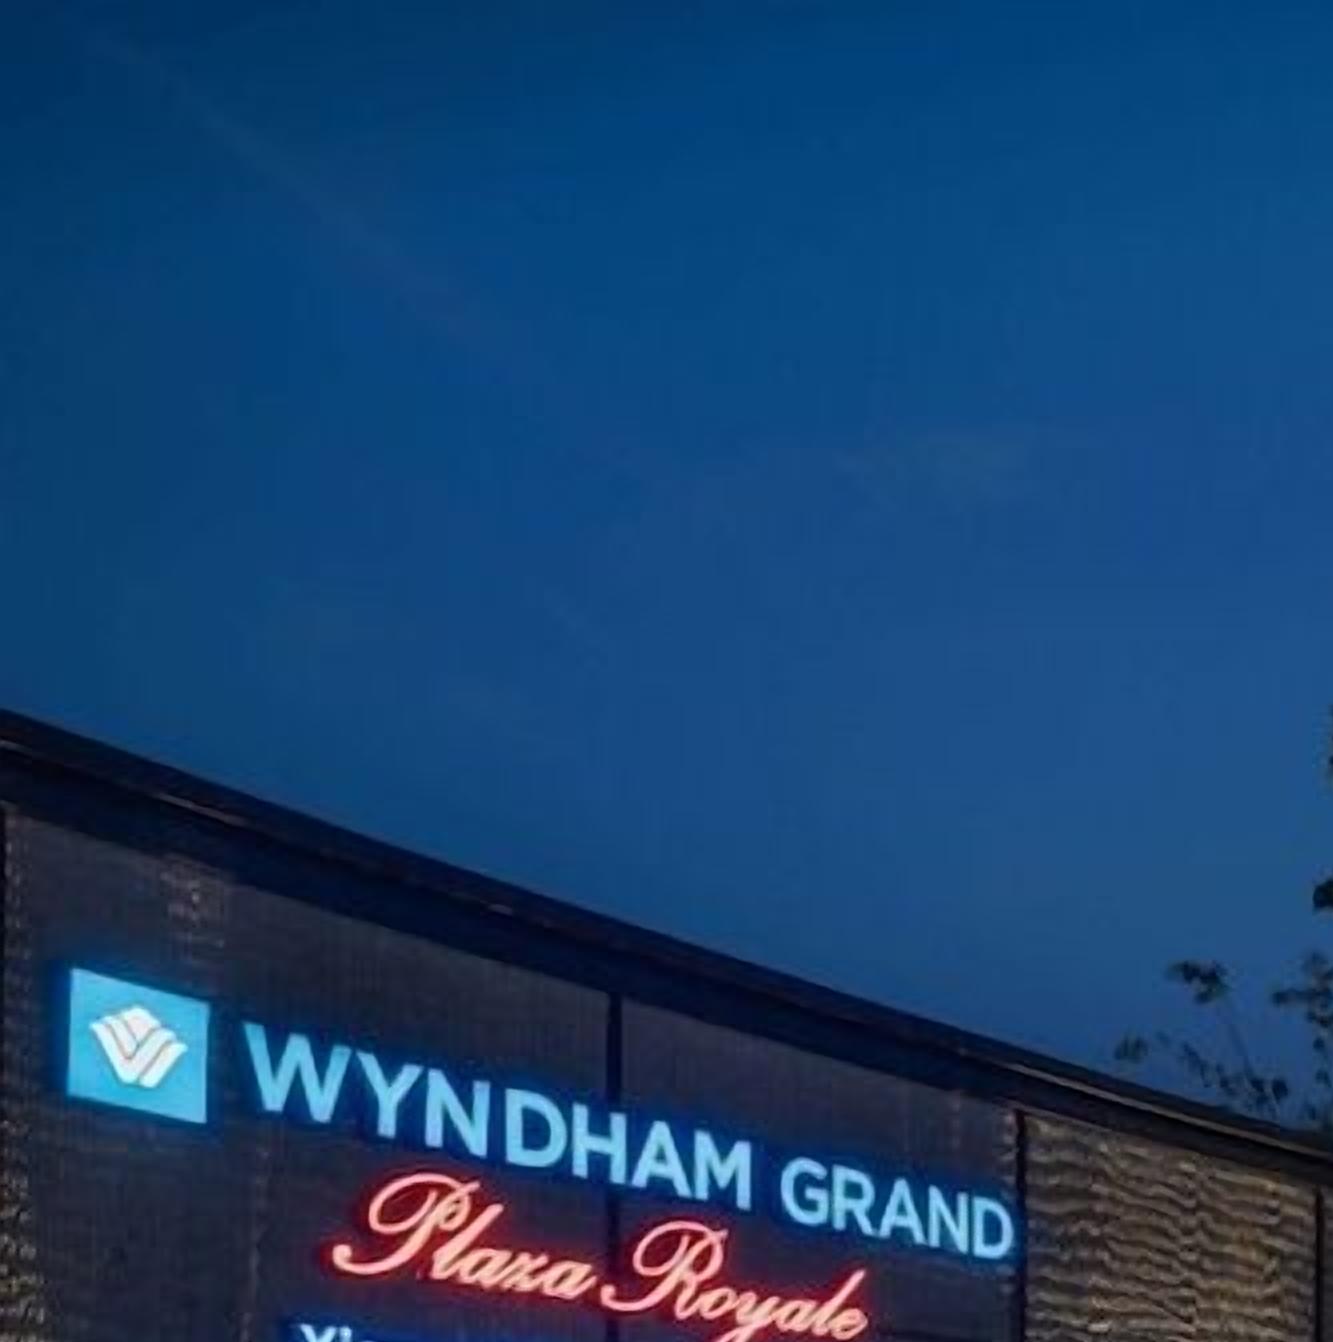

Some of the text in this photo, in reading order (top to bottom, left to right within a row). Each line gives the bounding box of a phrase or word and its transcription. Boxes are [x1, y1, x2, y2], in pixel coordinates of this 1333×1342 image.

[244, 1022, 1015, 1260] WYNDHAM GRAND
[333, 1173, 597, 1301] Plaza
